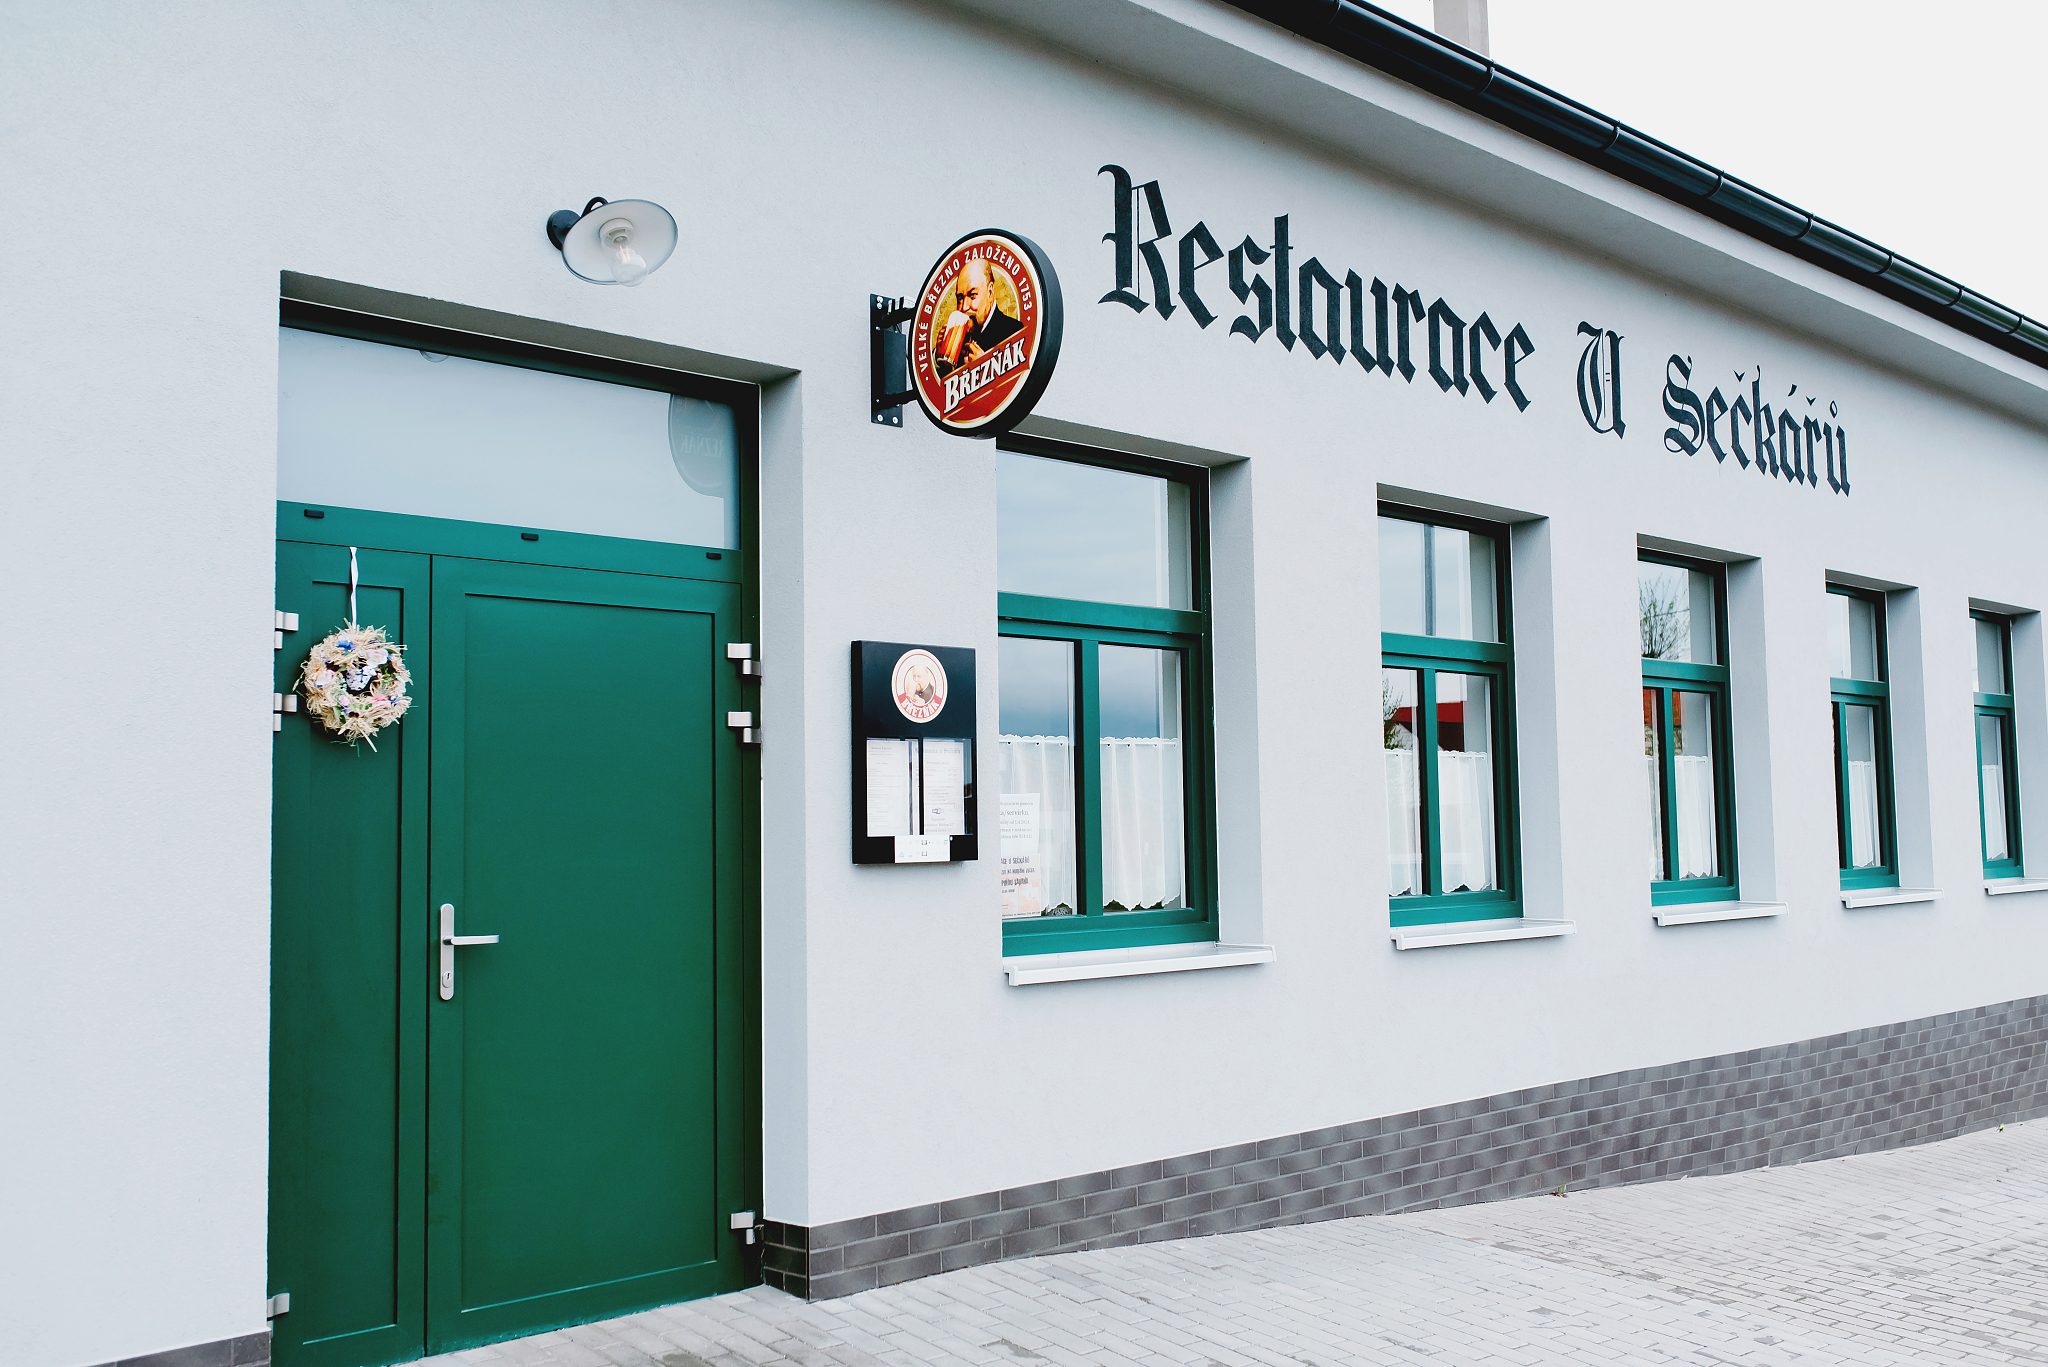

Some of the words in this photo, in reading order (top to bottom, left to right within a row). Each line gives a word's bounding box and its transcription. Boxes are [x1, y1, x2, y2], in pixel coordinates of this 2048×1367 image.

[917, 321, 930, 373] VELKÉ
[924, 260, 961, 315] BŘEZNO
[964, 244, 1021, 276] ZALOŽENO
[1018, 277, 1033, 312] 1753
[1097, 163, 1535, 413] Restaurace
[1576, 320, 1626, 440] U
[1661, 353, 1852, 498] Sečkářů
[943, 337, 1027, 414] BŘEZŇÁK
